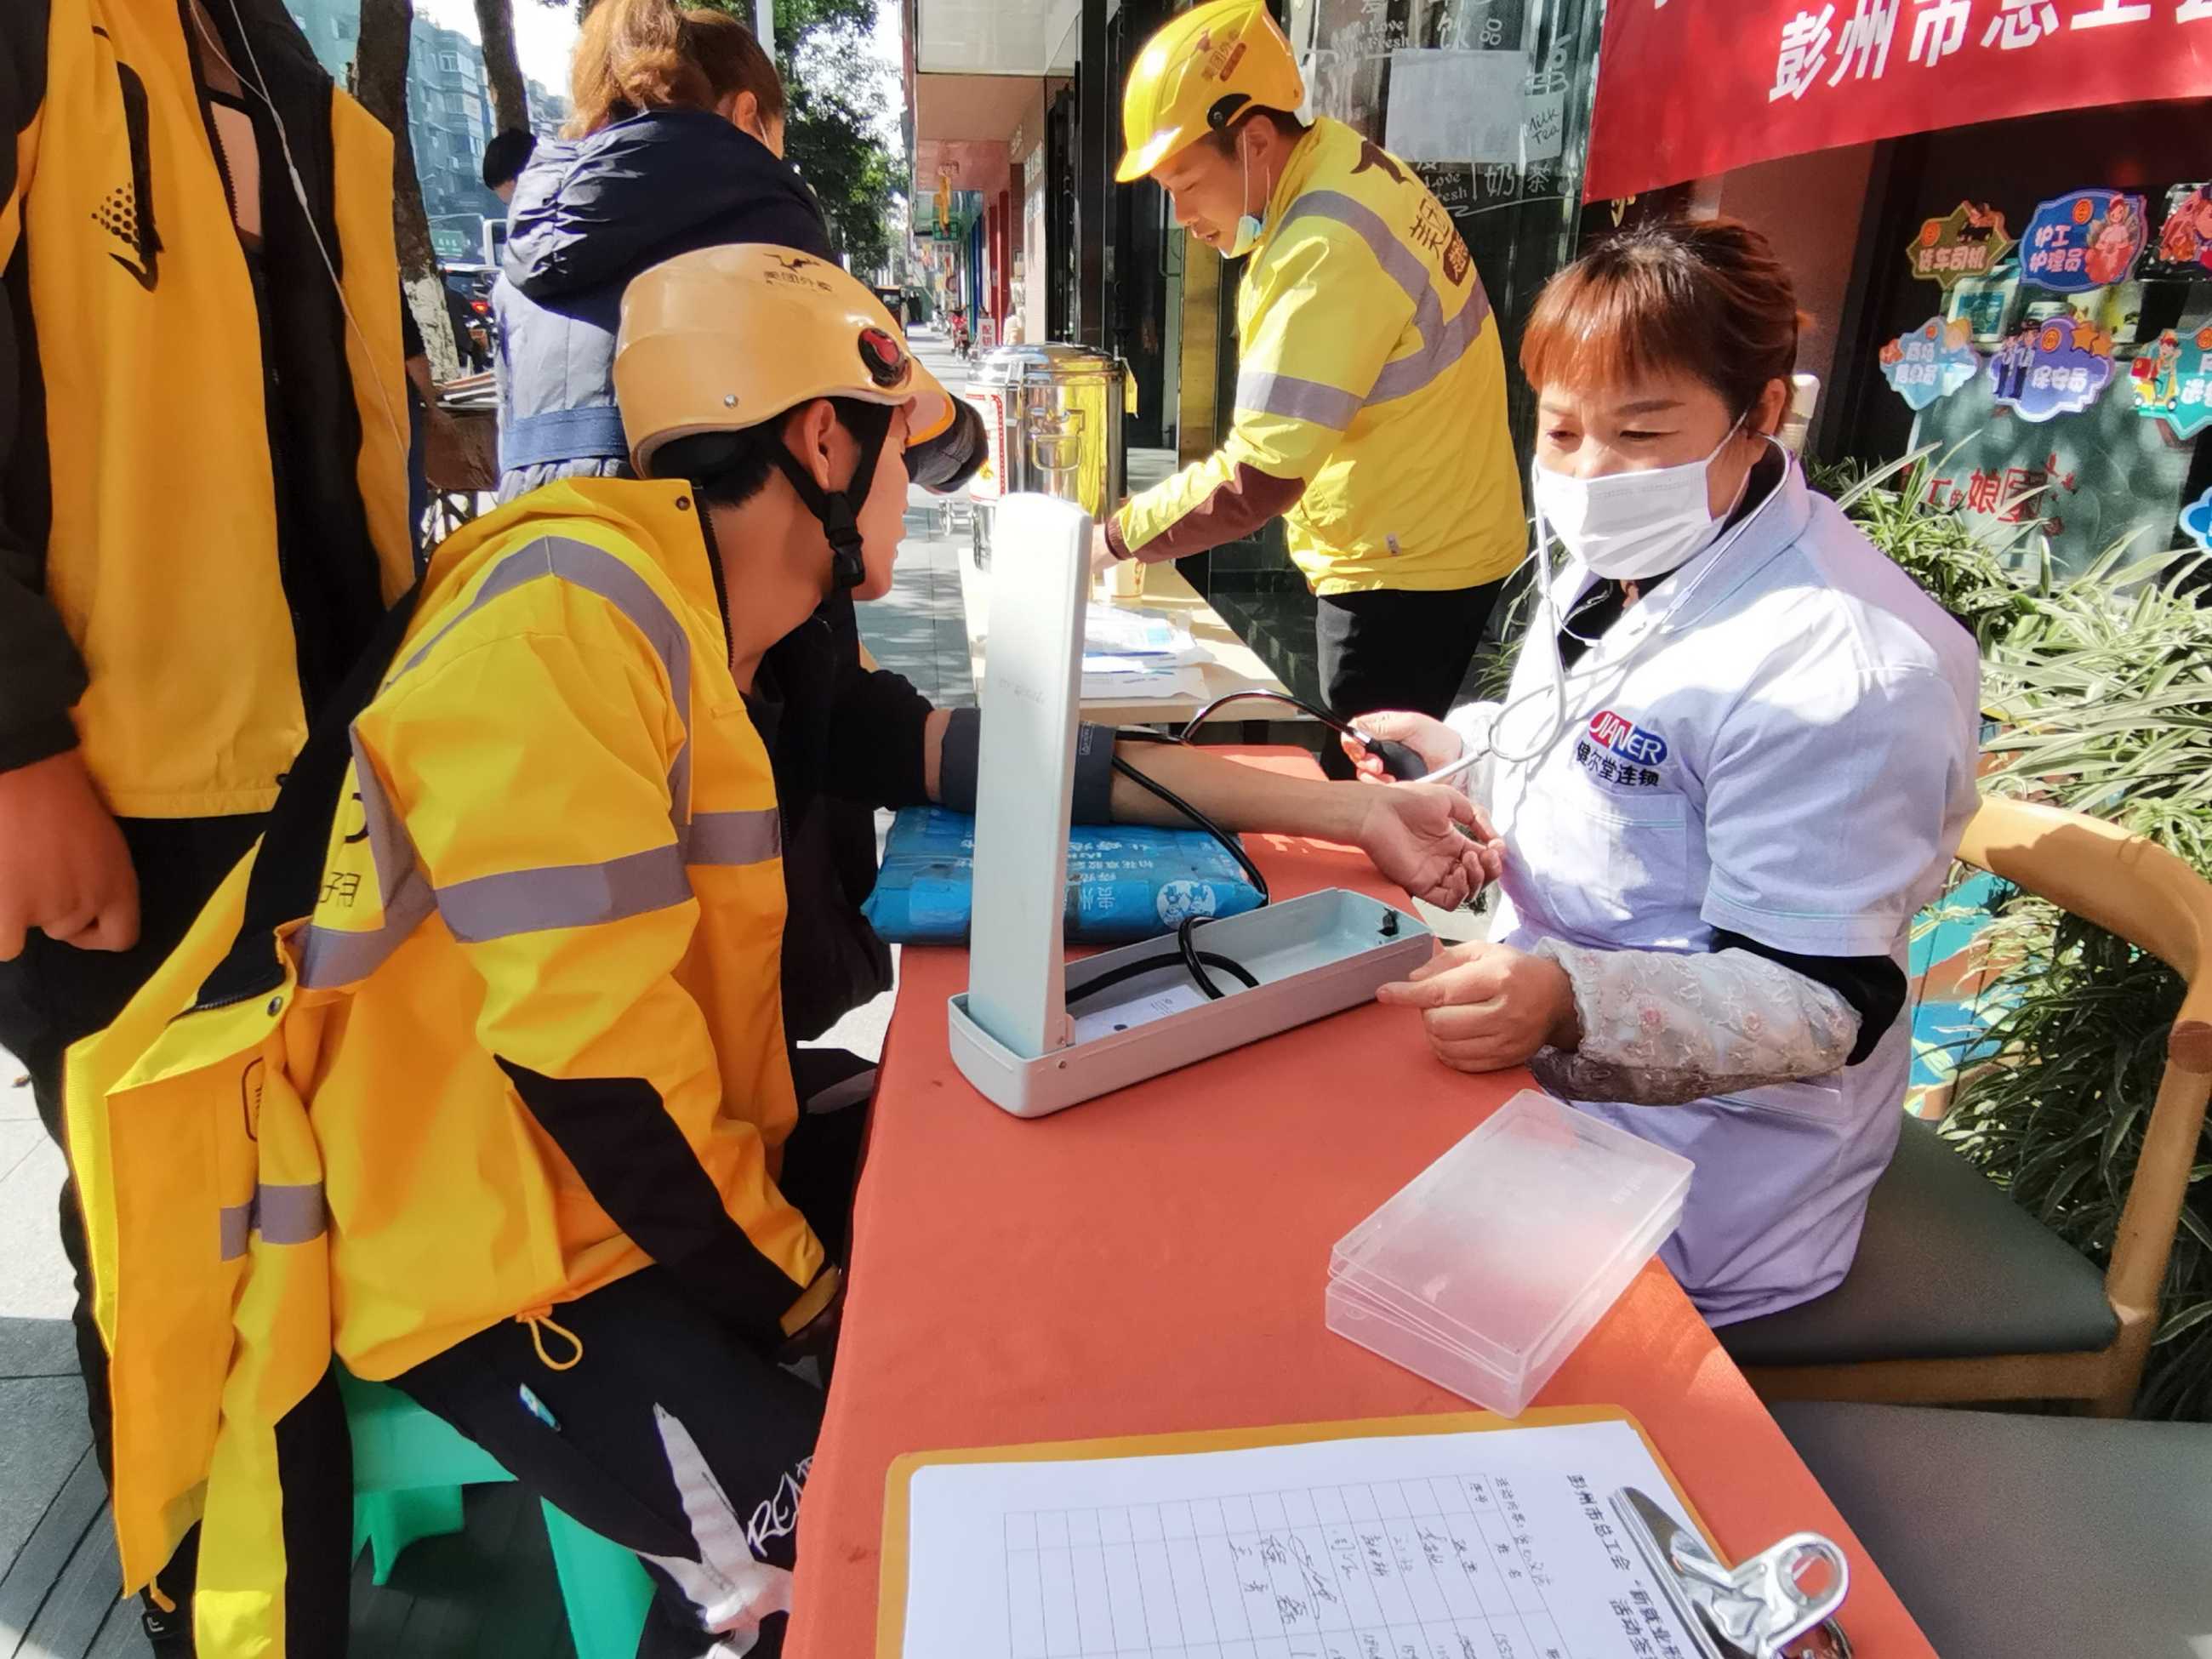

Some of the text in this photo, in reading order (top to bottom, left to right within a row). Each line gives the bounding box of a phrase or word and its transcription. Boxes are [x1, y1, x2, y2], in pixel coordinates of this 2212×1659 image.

[1769, 0, 2212, 103] 彭州市总
[1485, 162, 1550, 197] 奶茶
[1435, 186, 1468, 202] resh
[2035, 225, 2072, 248] 护工
[2029, 248, 2084, 273] 护理员
[2032, 365, 2089, 392] 保安员
[1589, 713, 1662, 764] JIANER
